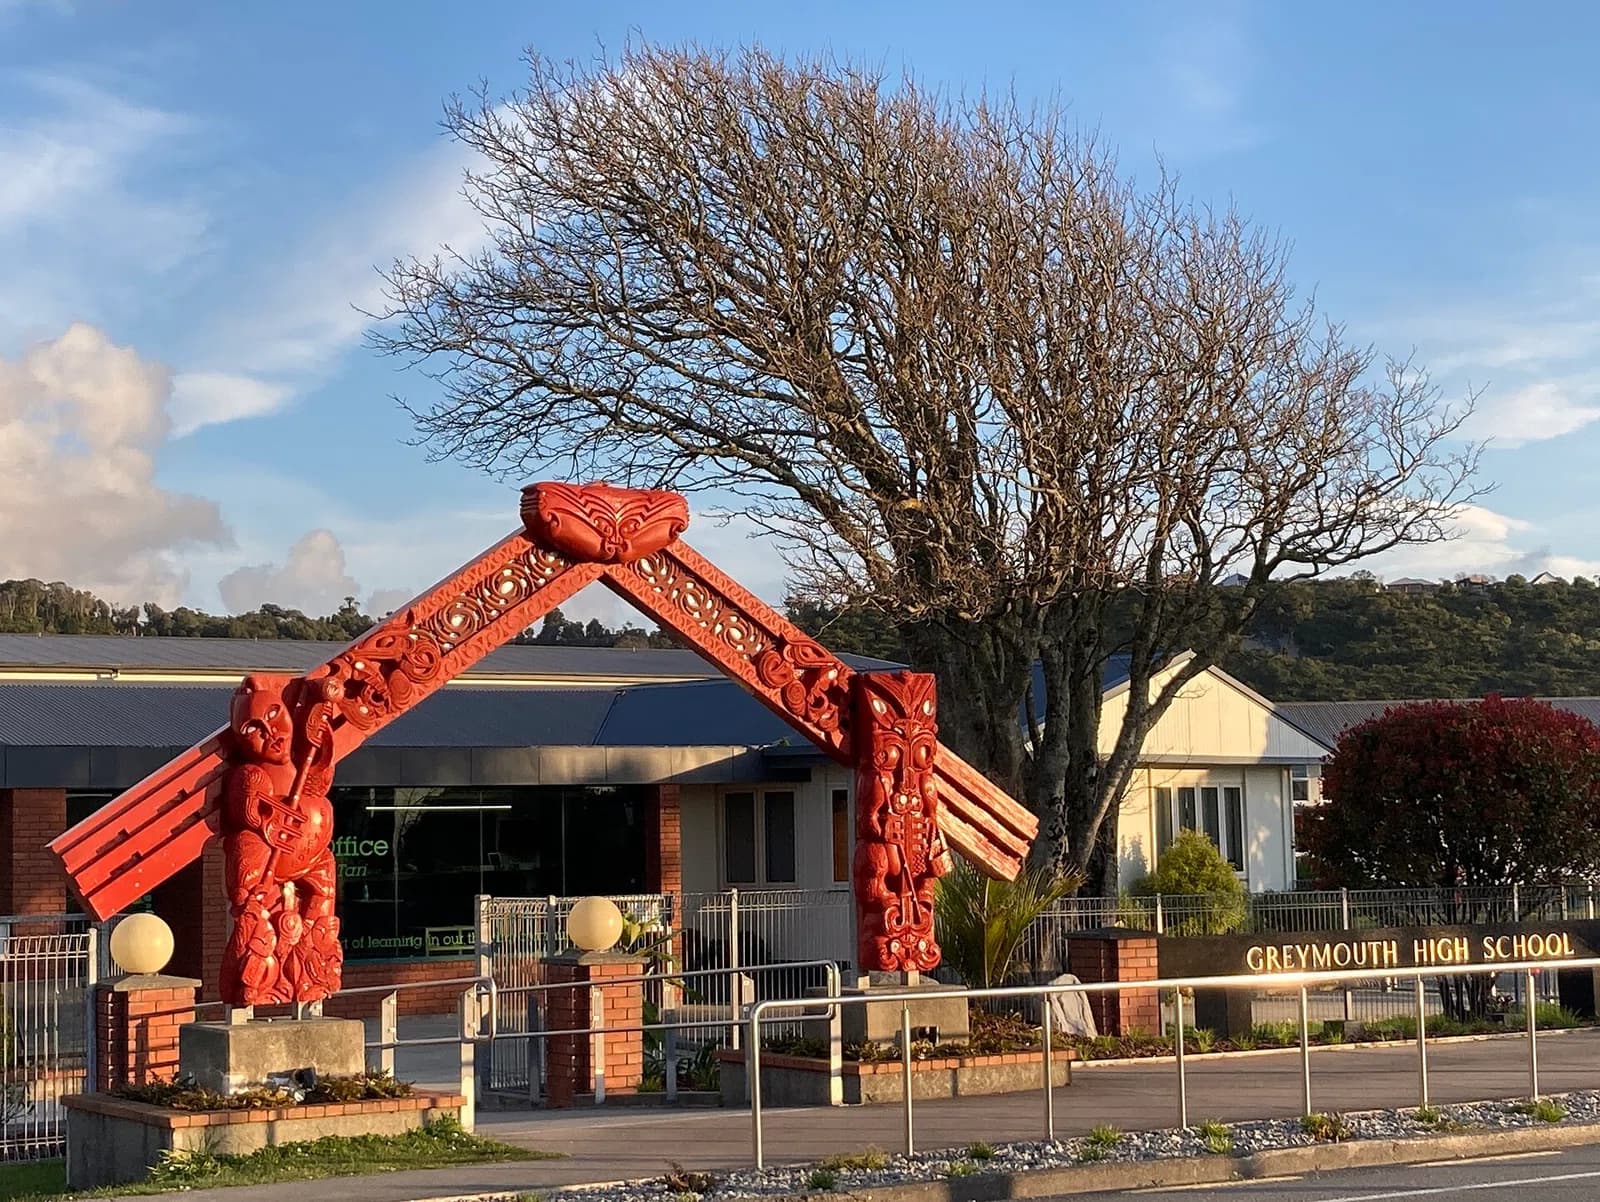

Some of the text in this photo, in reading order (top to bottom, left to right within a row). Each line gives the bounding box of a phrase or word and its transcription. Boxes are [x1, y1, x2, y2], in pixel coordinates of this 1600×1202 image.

[351, 935, 364, 949] of
[367, 934, 423, 949] learning
[443, 935, 464, 946] our
[1246, 932, 1575, 970] GREYMOUTH HIGH SCHOOL
